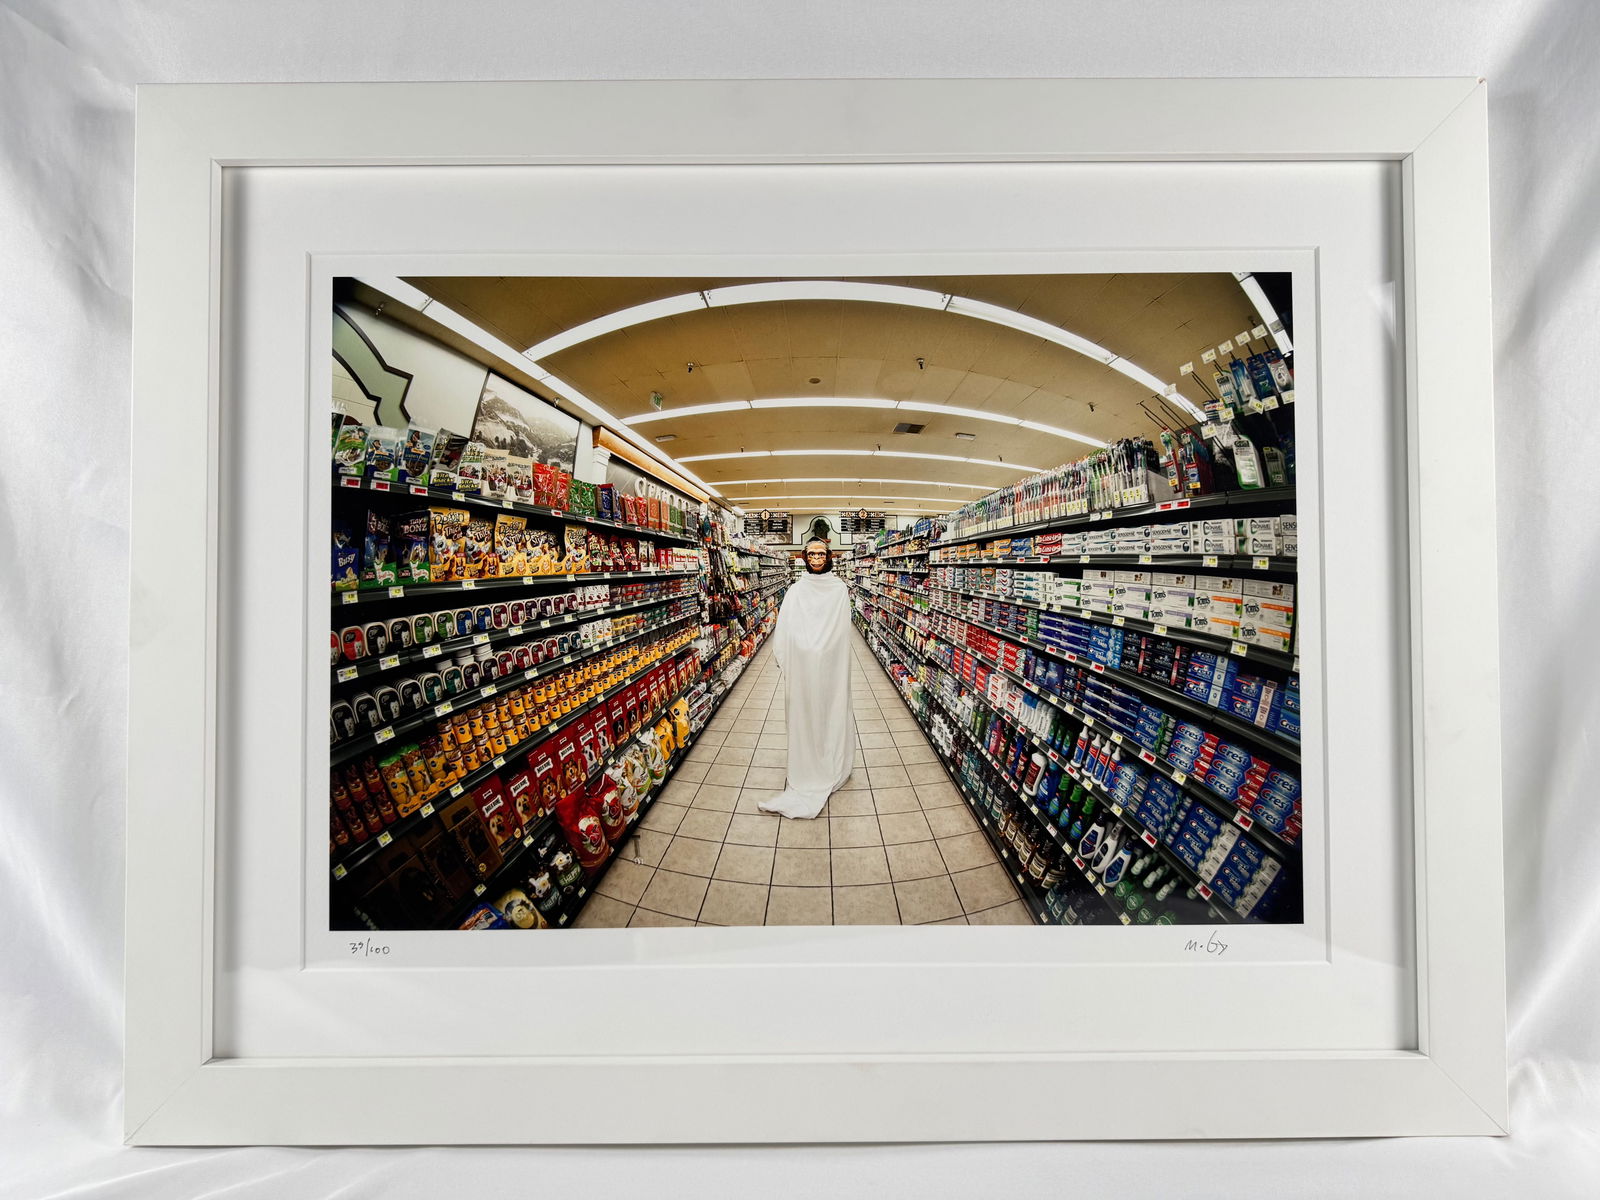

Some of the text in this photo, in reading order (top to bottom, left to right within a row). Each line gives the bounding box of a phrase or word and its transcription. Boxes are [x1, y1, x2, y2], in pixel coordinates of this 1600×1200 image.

[1153, 590, 1167, 600] Tom's
[1196, 595, 1211, 605] Tom's
[1150, 610, 1164, 618] Tom's
[1244, 603, 1260, 613] Tom's
[1193, 616, 1208, 626] Tom's
[1240, 626, 1257, 637] Tom's
[1177, 725, 1204, 742] Crest
[1172, 739, 1200, 757] Crest
[1217, 744, 1249, 766] Crest
[1168, 752, 1194, 770] Crest
[1212, 758, 1242, 781] Crest
[1205, 774, 1236, 796] Crest
[1268, 771, 1299, 794] Crest
[1261, 788, 1291, 811] Crest
[1252, 804, 1283, 827] Crest
